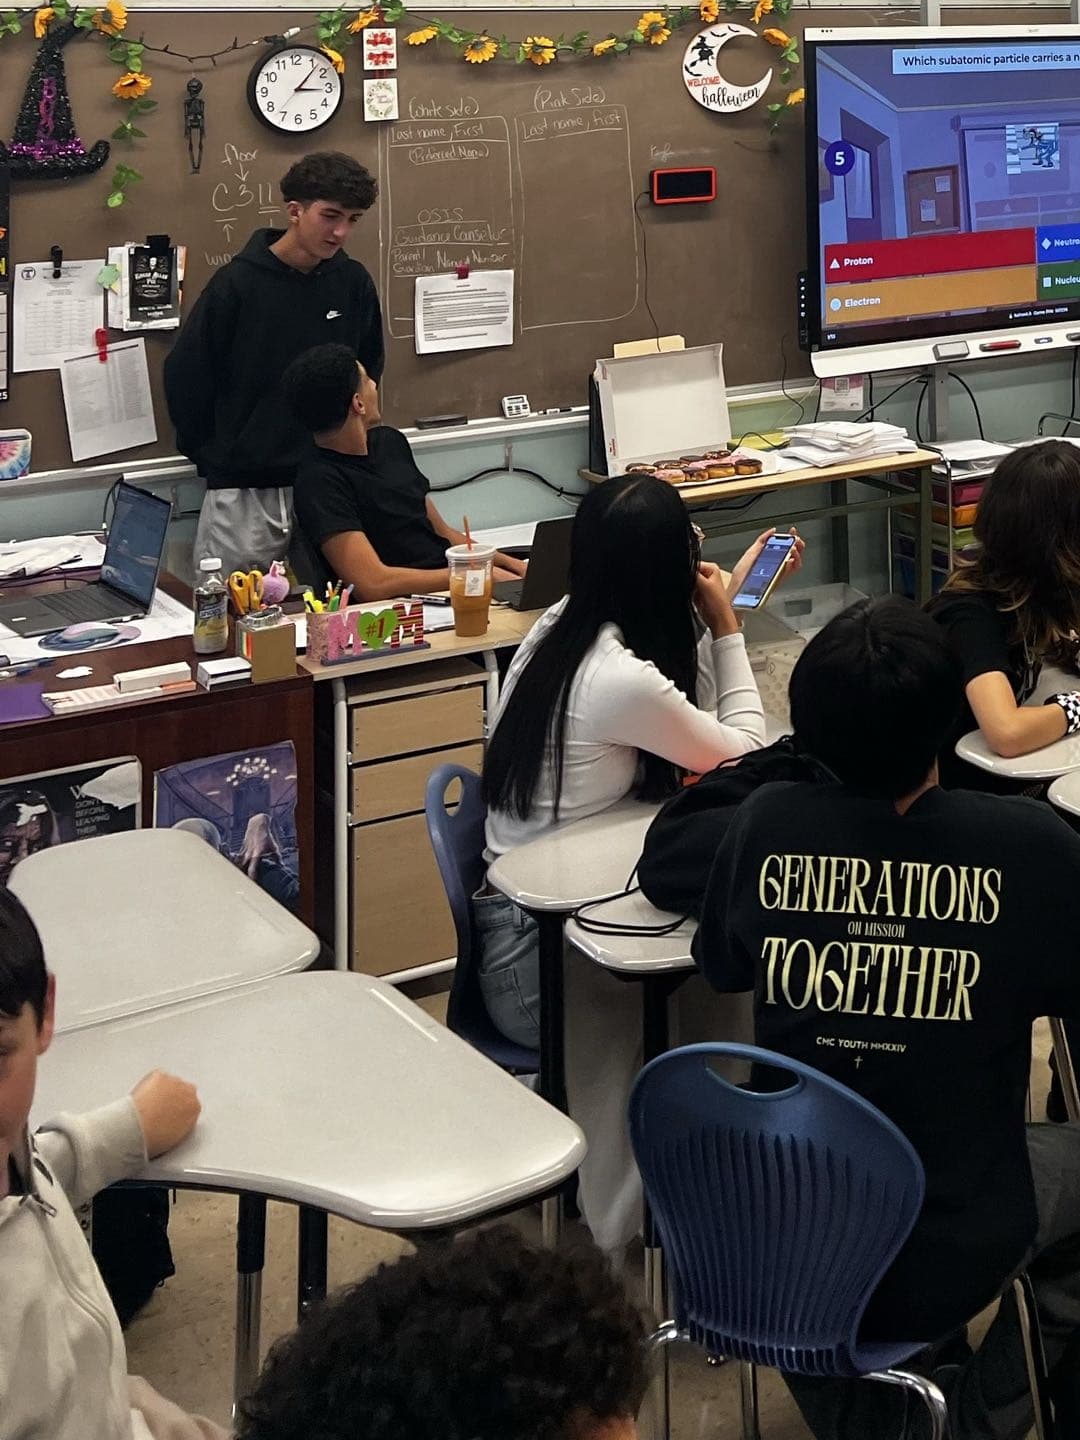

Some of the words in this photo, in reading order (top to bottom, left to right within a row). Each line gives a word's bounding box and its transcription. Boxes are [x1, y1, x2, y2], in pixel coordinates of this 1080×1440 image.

[276, 60, 287, 70] 11
[290, 54, 302, 66] 12
[310, 59, 315, 68] 1
[902, 54, 937, 67] Which
[938, 53, 991, 65] subatomic
[993, 52, 1030, 65] particle
[1032, 52, 1064, 63] carries
[1066, 54, 1072, 62] a
[264, 71, 277, 82] 10
[319, 68, 327, 79] 2
[687, 76, 720, 87] WELCOME
[260, 87, 268, 97] 9
[325, 83, 333, 93] 3
[702, 86, 761, 107] halloween
[266, 101, 275, 112] 8
[321, 98, 328, 108] 4
[280, 111, 288, 122] 7
[294, 114, 302, 124] 6
[310, 110, 317, 119] 5
[522, 117, 548, 139] Last
[391, 126, 414, 142] Last
[835, 151, 845, 165] 5
[844, 257, 873, 266] Proton
[845, 297, 881, 307] Electron
[327, 610, 362, 661] M
[366, 617, 386, 639] #1
[391, 600, 424, 649] M
[758, 853, 1002, 925] GENERATIONS
[847, 920, 862, 936] ON
[864, 922, 905, 938] MISSION
[760, 936, 981, 1021] TOGETHER
[816, 1036, 836, 1047] CMC
[838, 1038, 869, 1050] YOUTH
[870, 1041, 907, 1053] MMXXIV
